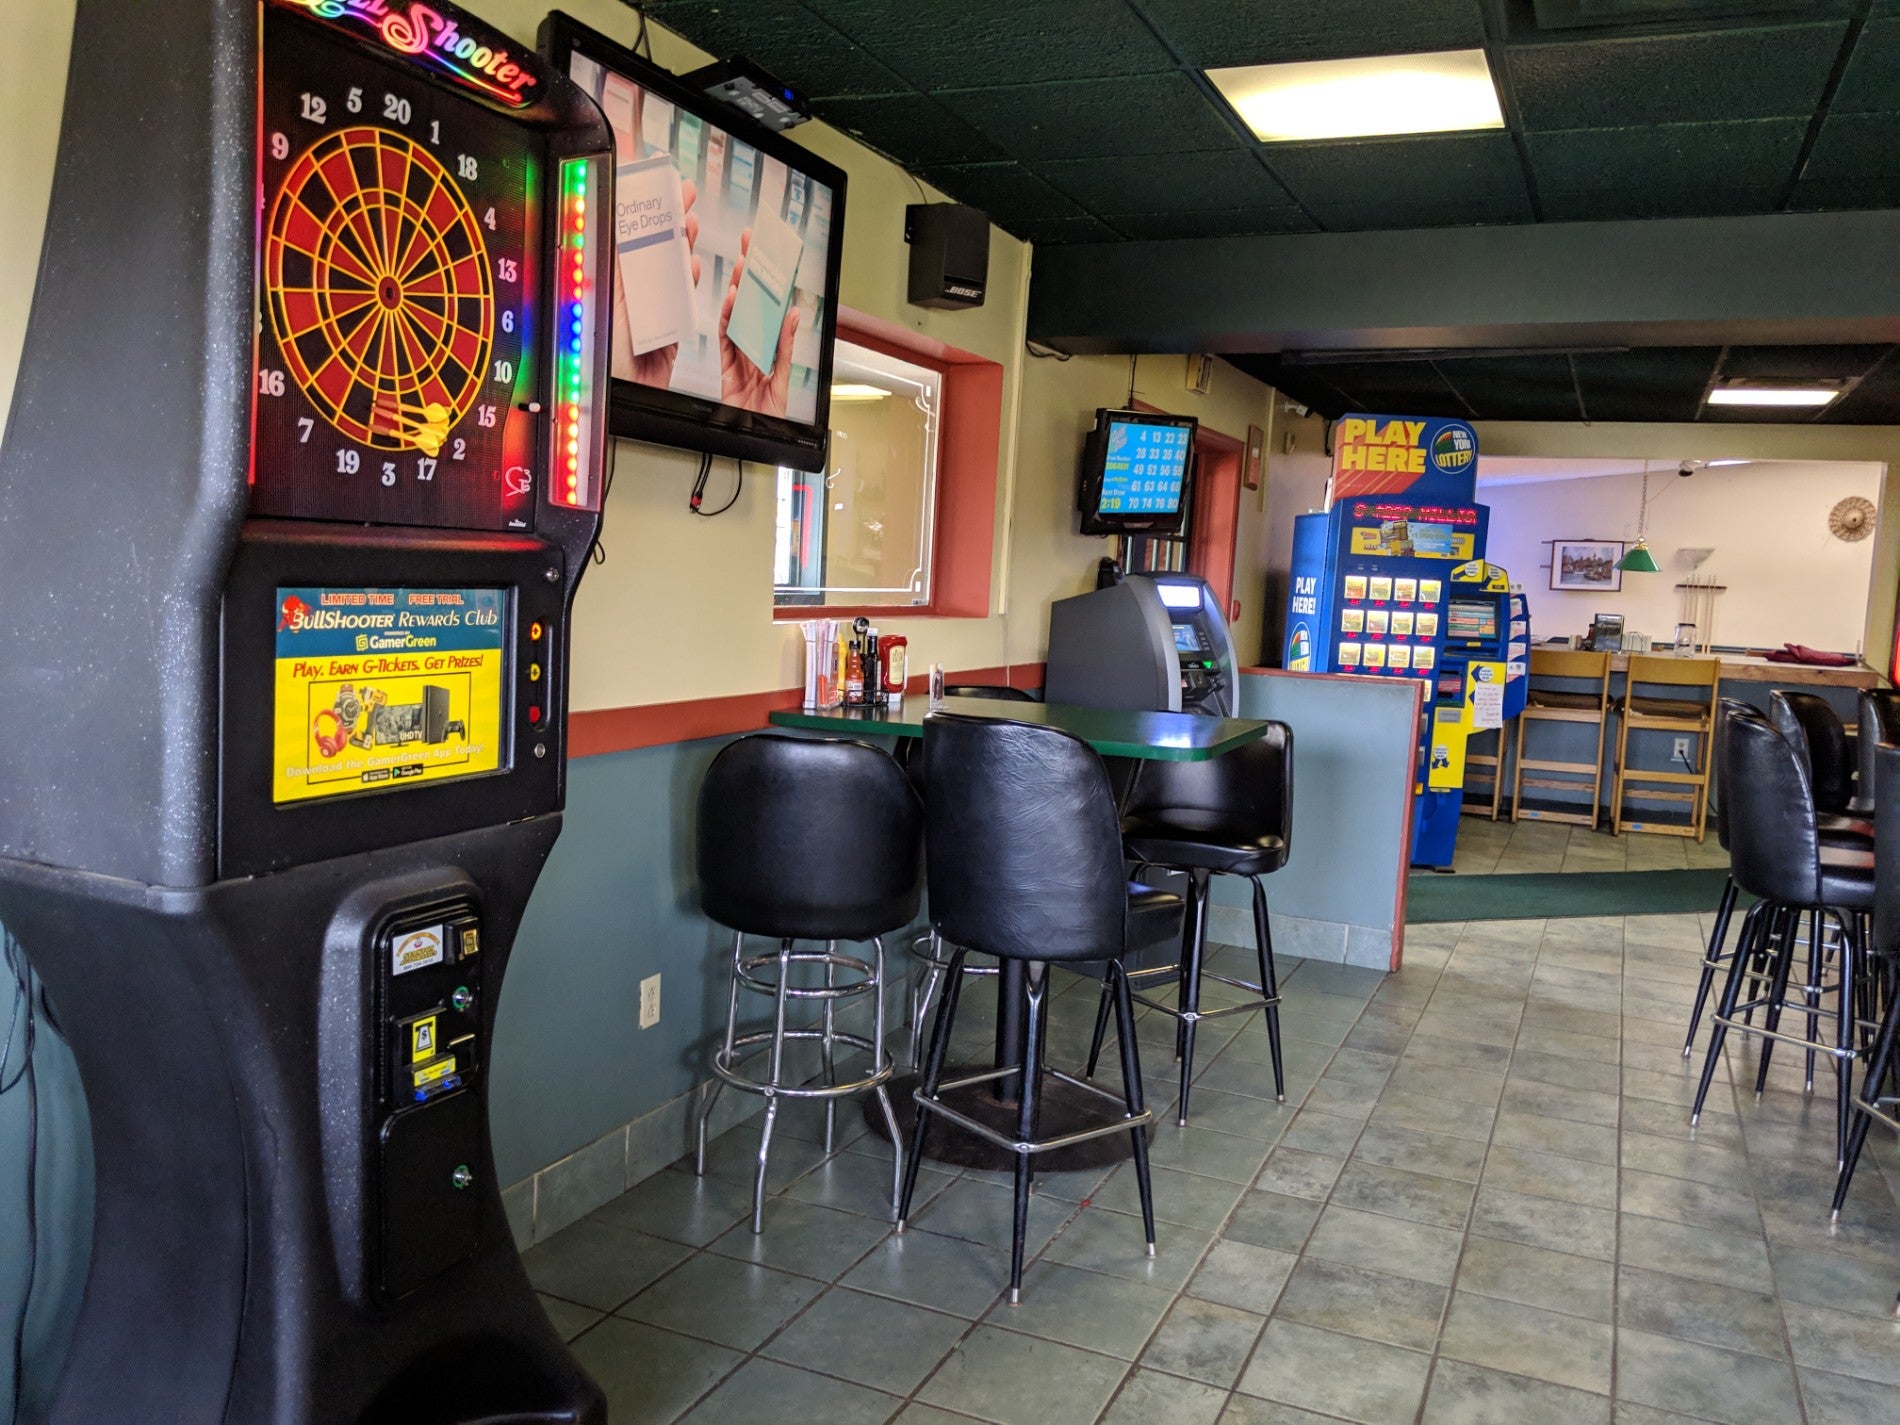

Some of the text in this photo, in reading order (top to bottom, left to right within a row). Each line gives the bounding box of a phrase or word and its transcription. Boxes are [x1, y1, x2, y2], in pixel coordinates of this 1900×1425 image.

[382, 3, 537, 91] Shooter
[301, 92, 327, 125] 12
[347, 87, 362, 113] 5
[383, 93, 411, 125] 20
[430, 121, 440, 145] 1
[272, 132, 289, 160] 9
[457, 154, 478, 181] 18
[484, 207, 496, 231] 4
[616, 197, 662, 217] Ordinary
[618, 211, 673, 235] Eye Drops
[498, 258, 517, 282] 13
[947, 286, 981, 298] BOSE
[501, 310, 514, 333] 6
[259, 369, 285, 397] 16
[494, 360, 512, 384] 10
[478, 404, 496, 428] 15
[298, 417, 314, 443] 7
[1344, 418, 1426, 446] PLAY
[1452, 430, 1467, 439] NEW
[452, 438, 466, 460] 2
[1454, 438, 1471, 451] YORK
[336, 449, 360, 474] 19
[417, 457, 437, 481] 17
[1342, 445, 1427, 473] HERE
[1435, 450, 1472, 468] LOTTERY
[381, 462, 396, 486] 3
[1295, 576, 1317, 595] PLAY
[320, 593, 464, 606] LIMITED TIME FREE TRIAL
[1292, 596, 1316, 615] HERE!
[398, 610, 460, 627] Rewards
[464, 609, 498, 626] Club
[370, 633, 437, 649] GamerGreen
[293, 661, 324, 680] Play.
[329, 661, 359, 675] Earn
[424, 657, 445, 670] Get
[448, 654, 484, 669] Prizes!
[286, 743, 484, 777] Download the GamerGreen App Today!
